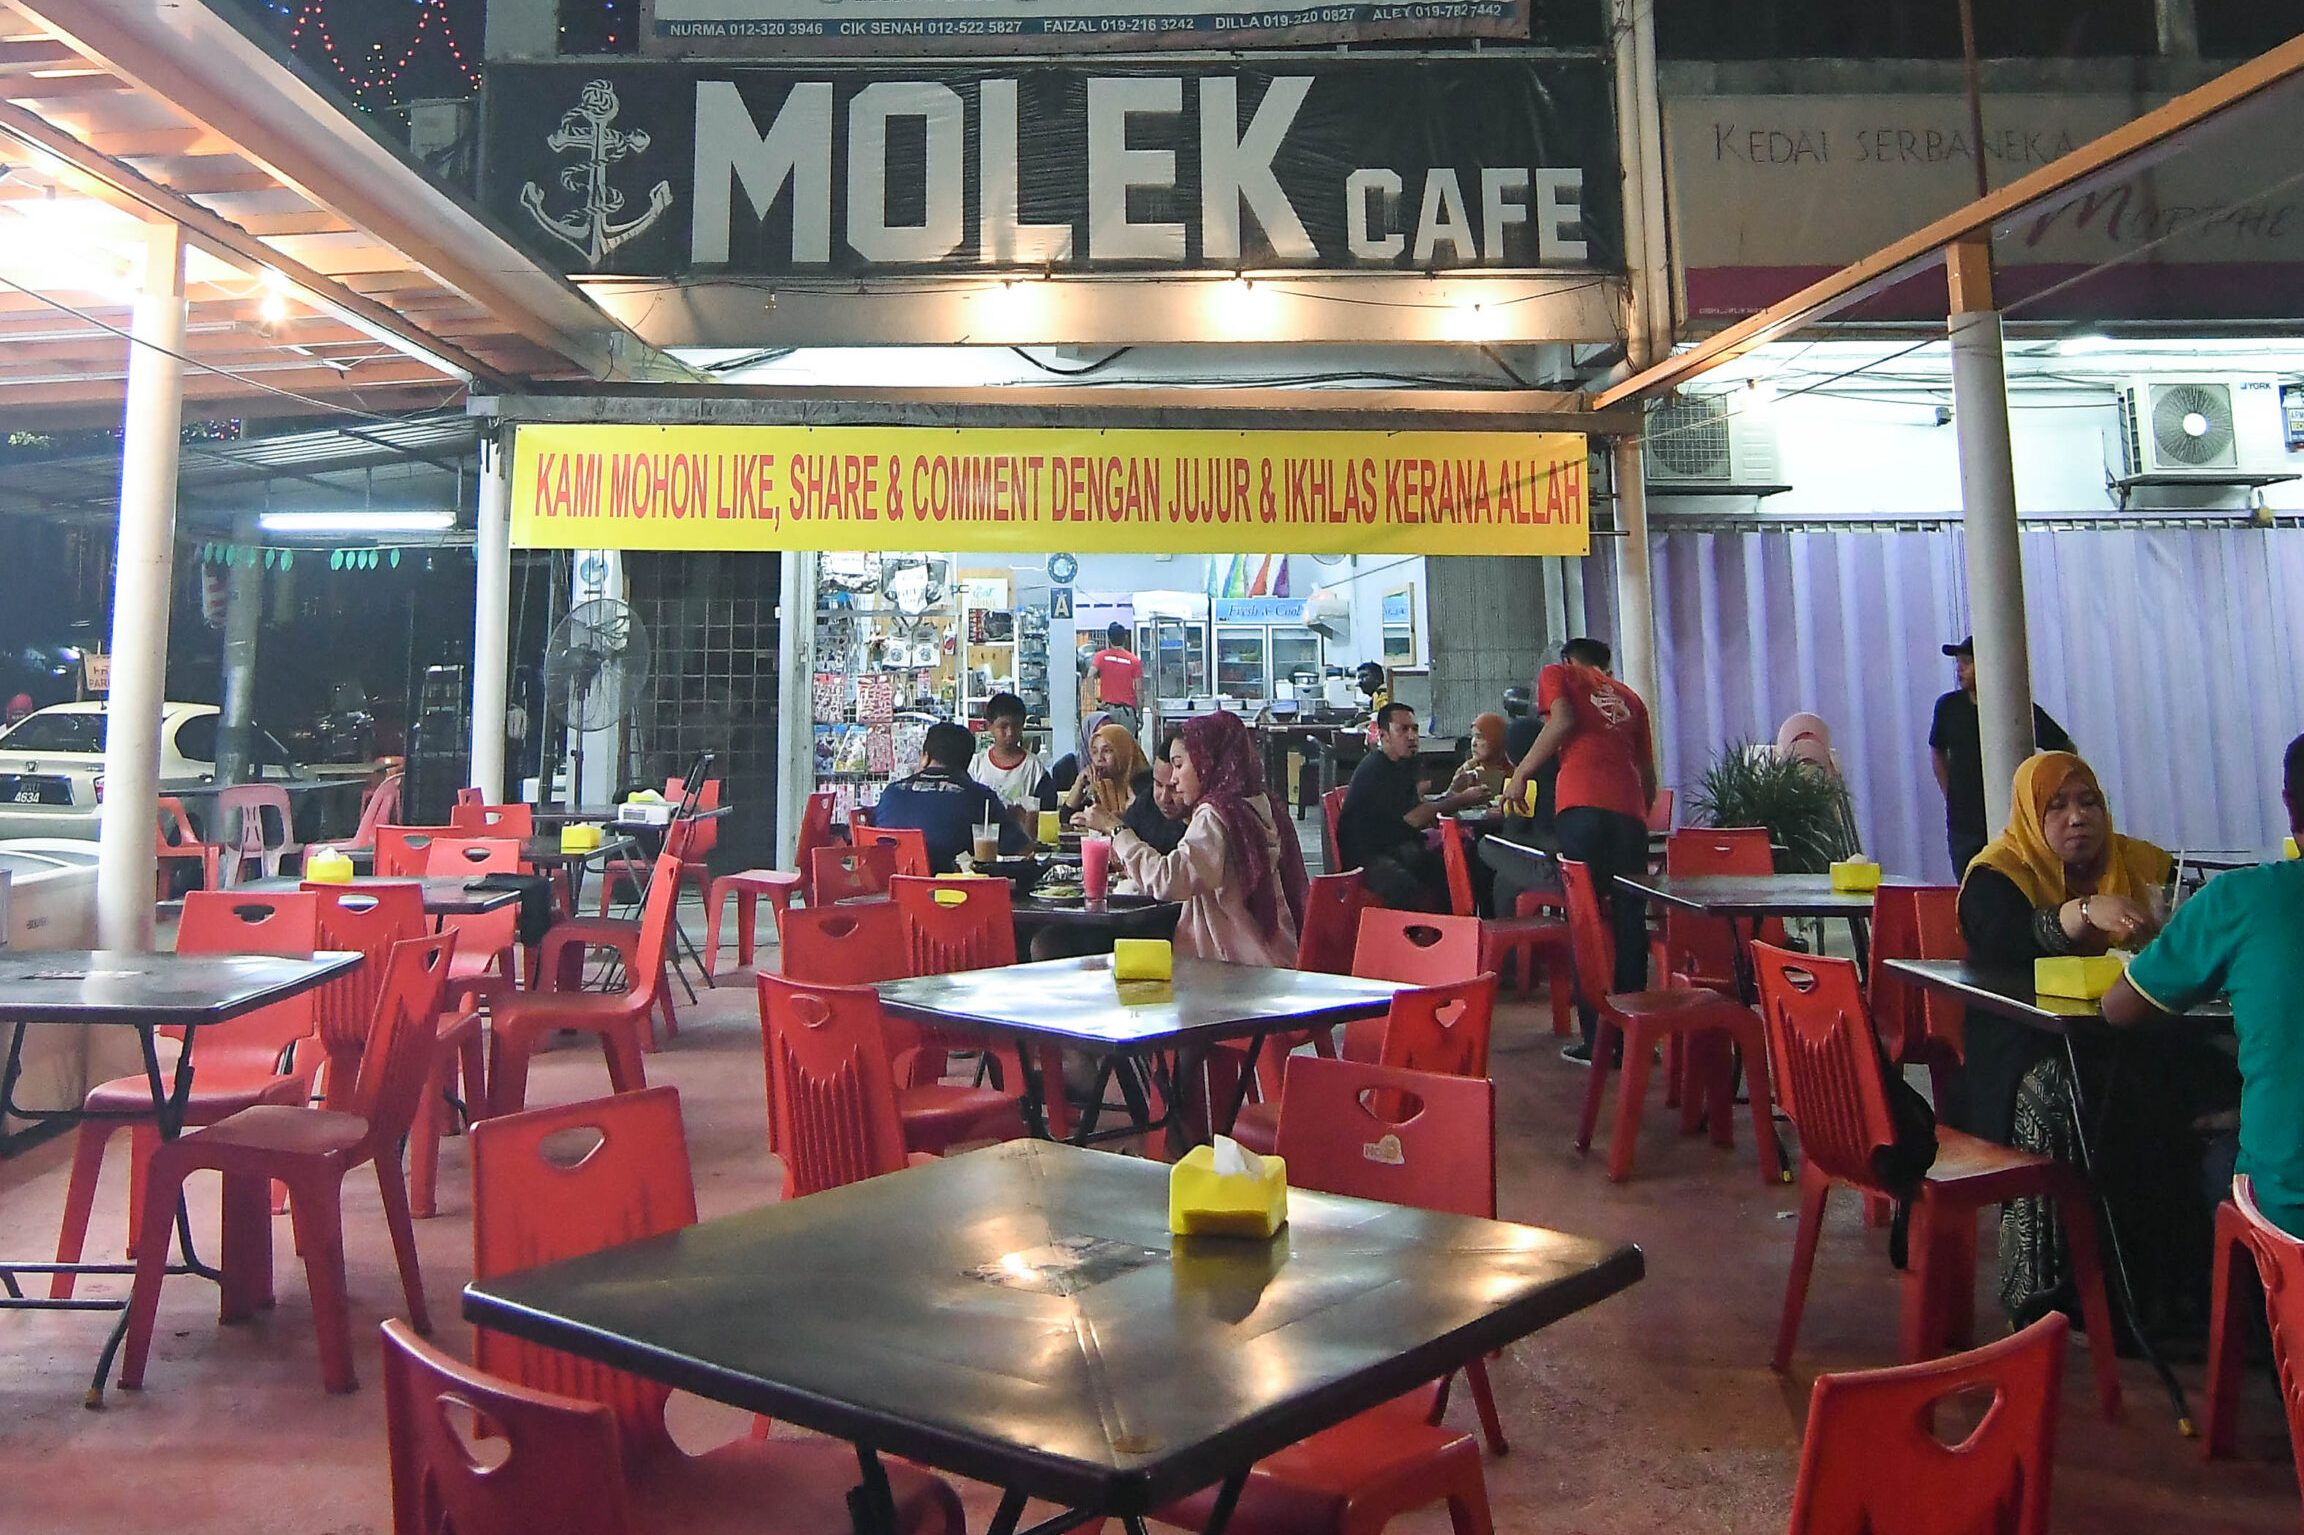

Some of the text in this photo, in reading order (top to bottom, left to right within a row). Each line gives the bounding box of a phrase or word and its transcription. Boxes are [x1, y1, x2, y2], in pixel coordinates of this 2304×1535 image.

[1470, 4, 1502, 16] 7442
[1043, 18, 1194, 33] FAIZAL 019-216 3242
[1214, 7, 1356, 30] DILLA 019-220 0827
[670, 22, 823, 36] NURMA 012-320 3946
[839, 20, 1022, 35] CIK SENAH 012-522 5827
[1713, 122, 1830, 166] KEDAI
[691, 74, 1589, 265] MOLEK CAFE
[534, 453, 1582, 532] KAMI MOHON LIKE, SHARE & COMMENT DENGAN JUJUR & IKHLAS KERANA ALLAH
[1053, 593, 1070, 617] A
[1229, 604, 1259, 617] Fresh
[15, 792, 41, 803] 4634
